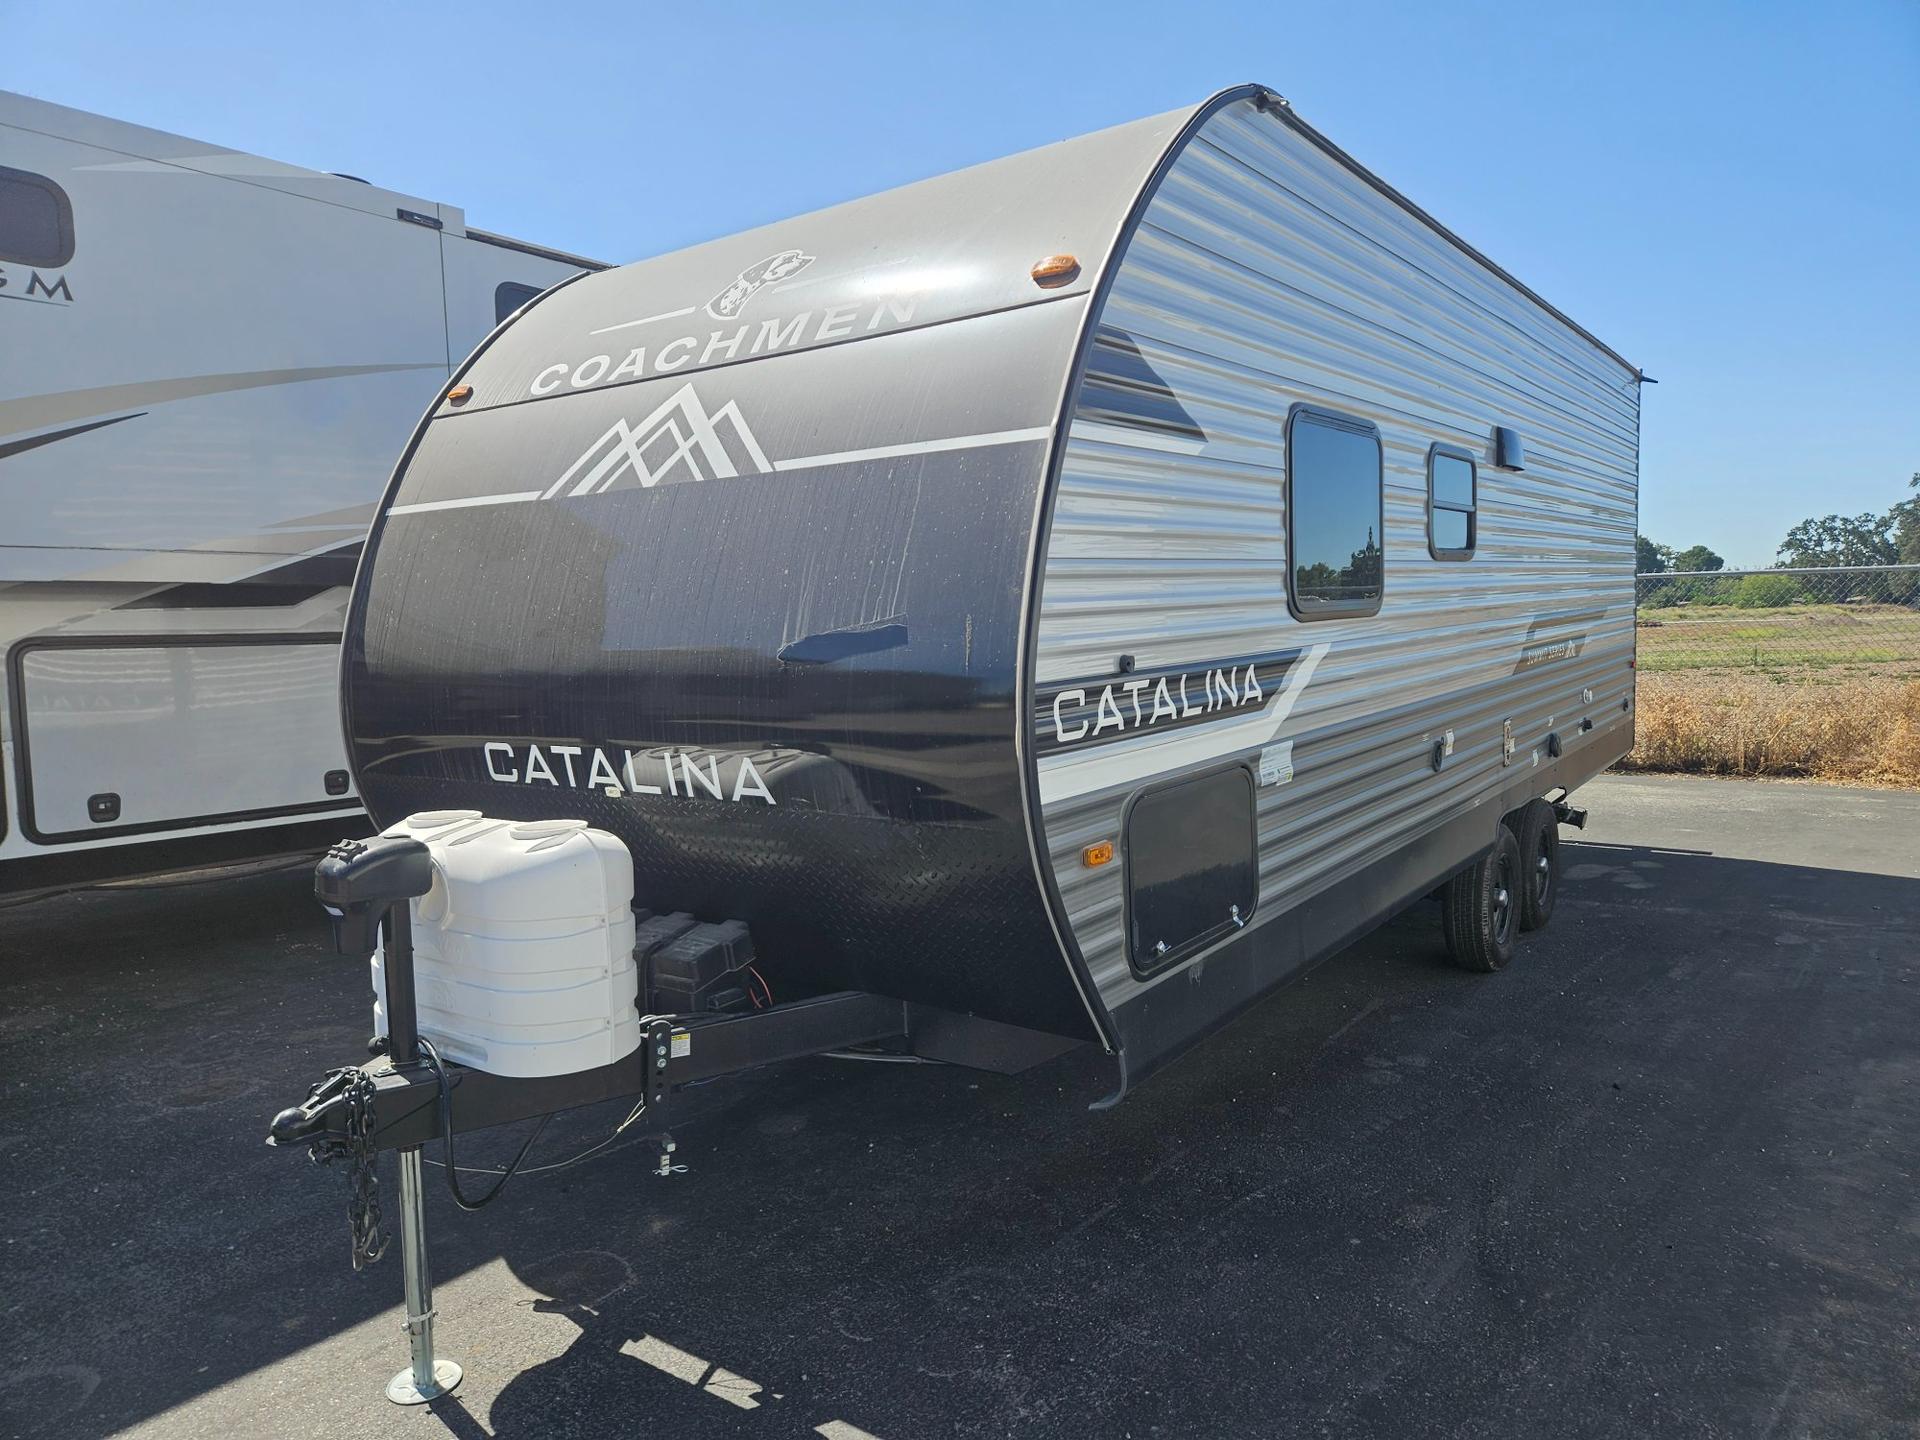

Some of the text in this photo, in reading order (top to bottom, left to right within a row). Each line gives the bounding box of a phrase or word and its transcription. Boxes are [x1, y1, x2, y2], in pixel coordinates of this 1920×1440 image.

[529, 296, 918, 396] COACHMEN
[1053, 663, 1263, 742] CATALINA
[484, 742, 777, 805] CATALINA
